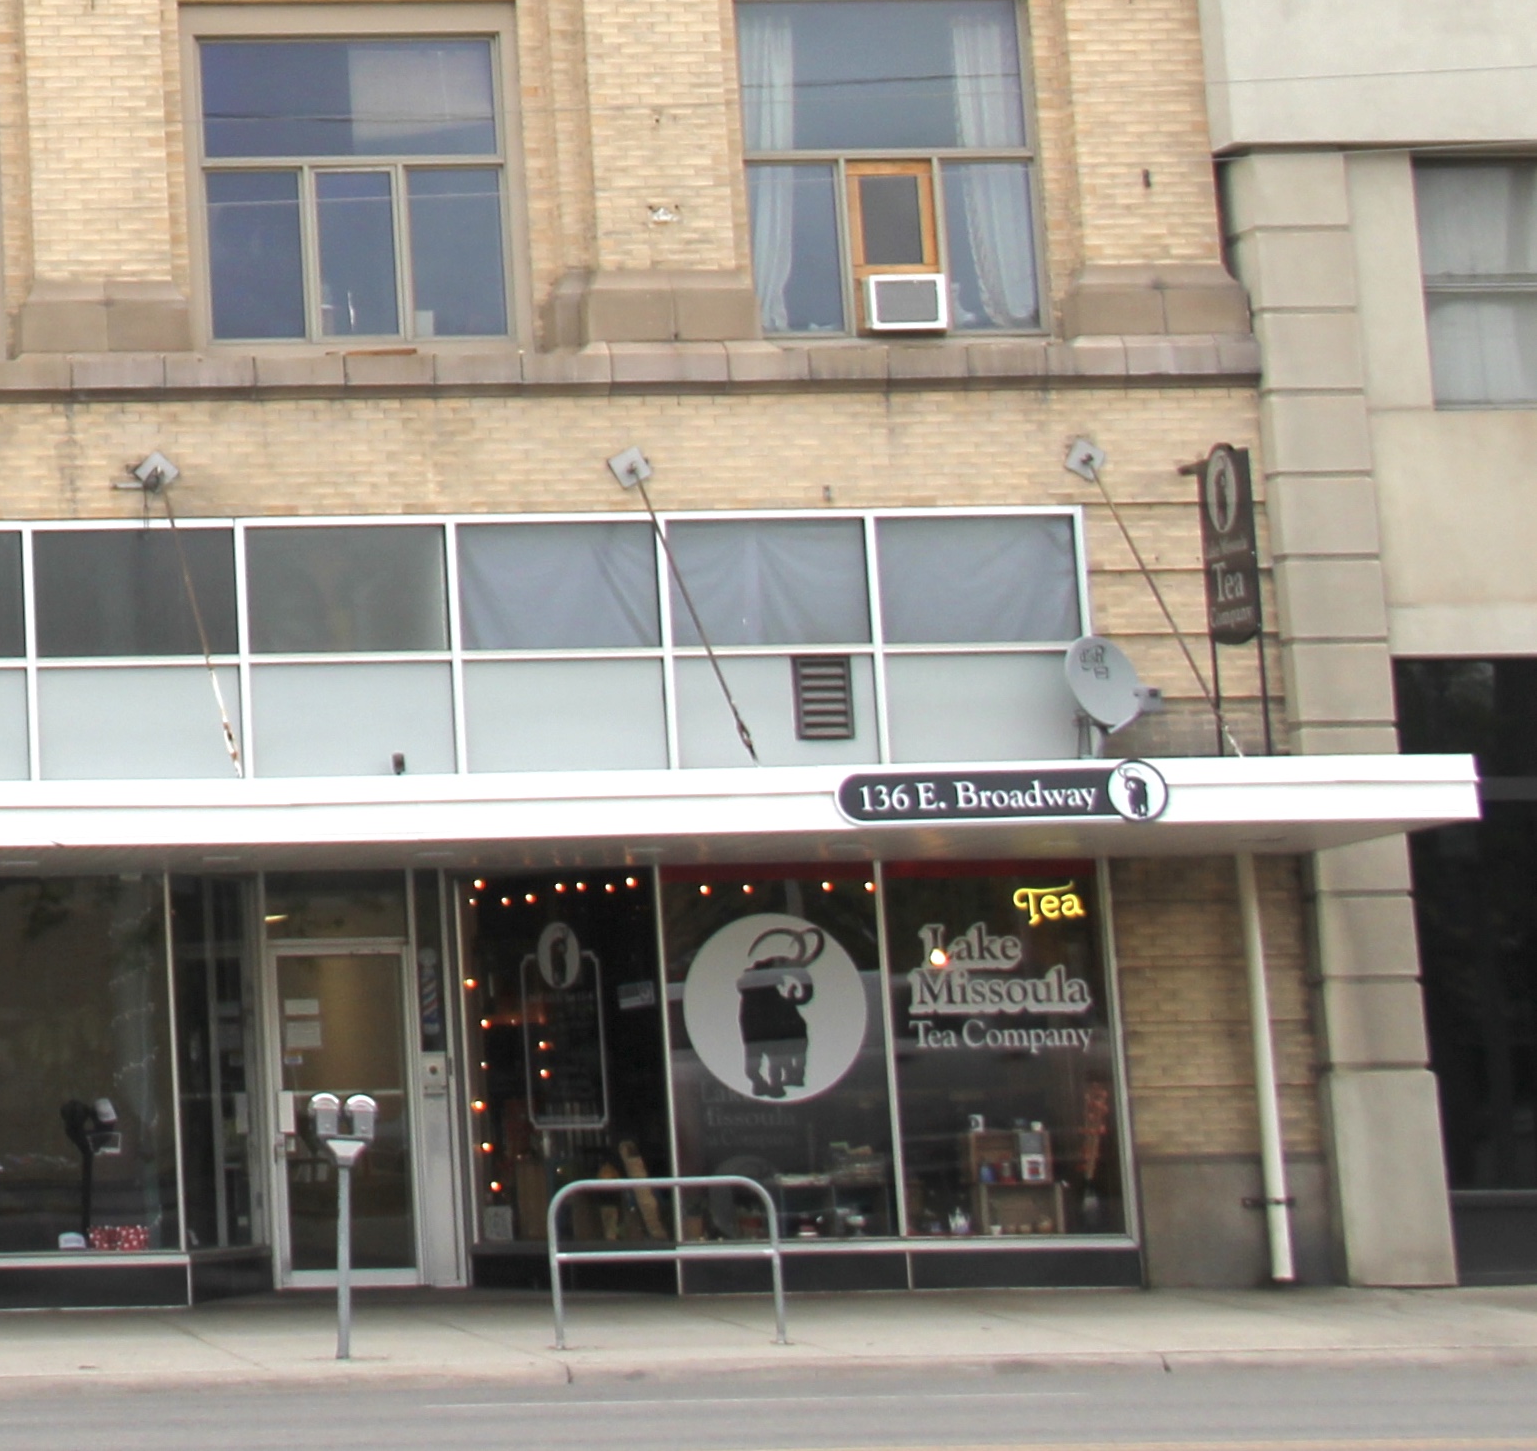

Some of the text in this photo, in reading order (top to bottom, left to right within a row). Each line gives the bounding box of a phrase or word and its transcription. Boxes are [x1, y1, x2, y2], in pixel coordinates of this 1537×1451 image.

[1211, 561, 1245, 602] Tea
[860, 779, 1096, 812] 136 E. Broadway
[1013, 880, 1086, 926] Tea
[920, 923, 1022, 965] Lake
[911, 965, 1089, 1008] Missoula
[909, 1019, 1092, 1054] Tea Company
